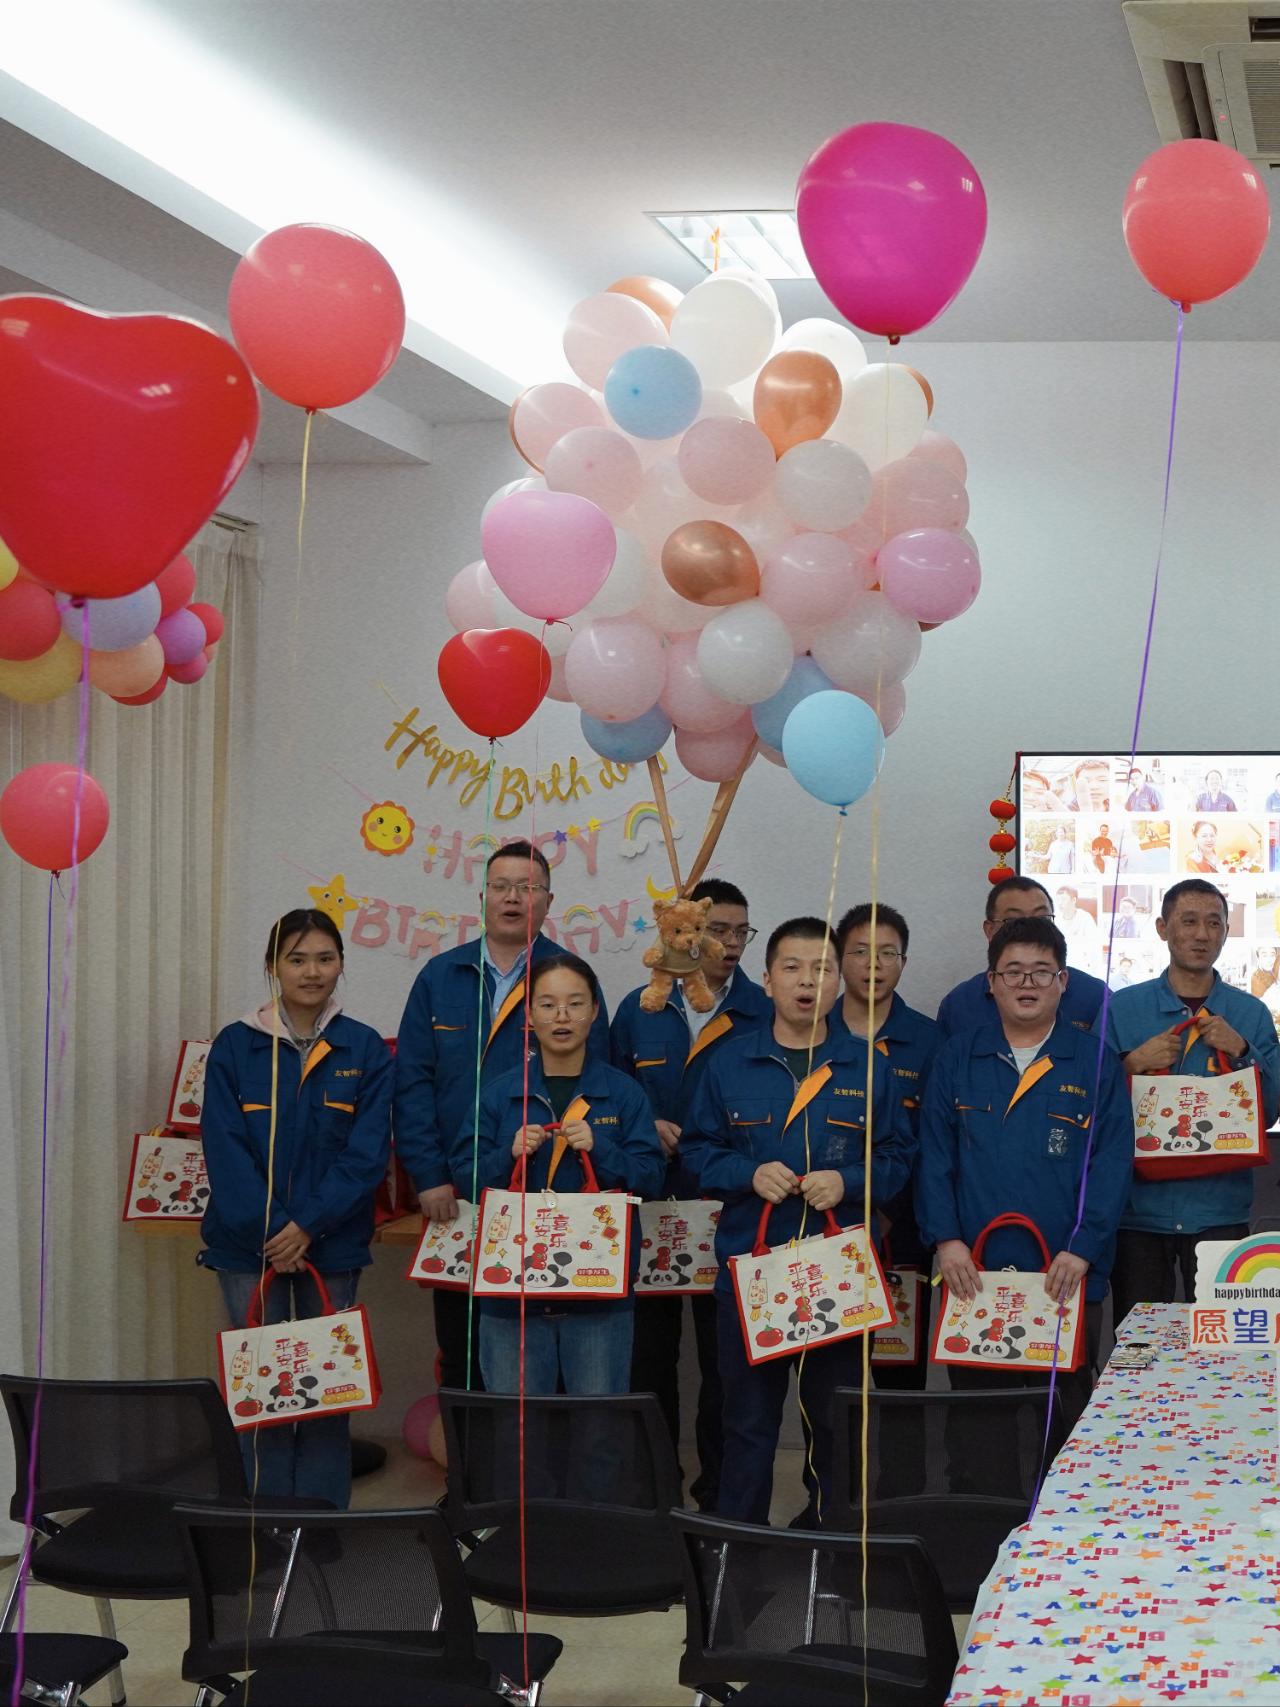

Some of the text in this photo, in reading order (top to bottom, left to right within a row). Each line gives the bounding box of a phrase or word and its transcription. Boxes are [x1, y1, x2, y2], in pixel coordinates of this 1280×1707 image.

[384, 706, 496, 807] Happy
[833, 1088, 865, 1098] 友智科技
